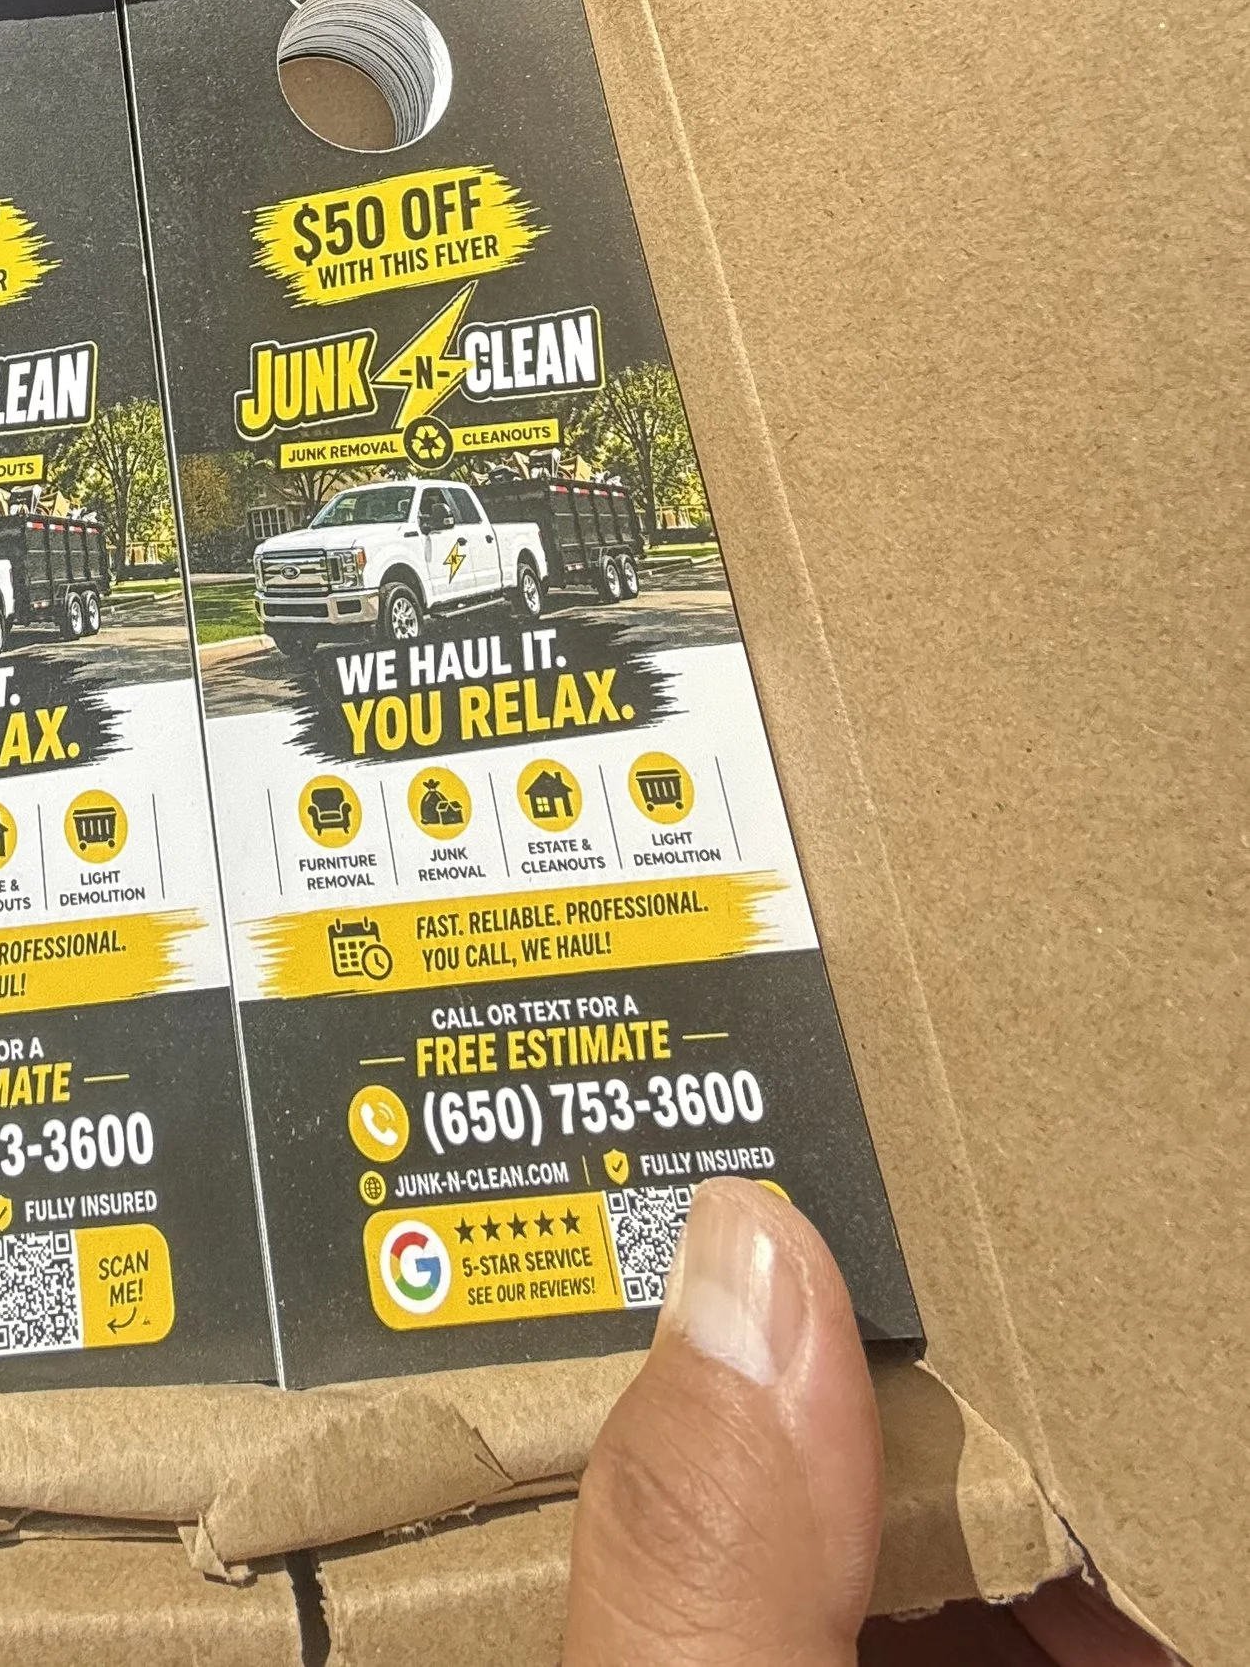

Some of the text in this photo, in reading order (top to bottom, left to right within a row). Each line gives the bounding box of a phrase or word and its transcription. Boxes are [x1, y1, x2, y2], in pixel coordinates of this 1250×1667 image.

[293, 176, 481, 266] $50 OFF
[318, 234, 500, 290] WITH THIS FLYER
[241, 337, 369, 431] JUNK
[463, 314, 596, 394] CLEAN
[462, 426, 551, 446] CLEANOUTS
[288, 439, 398, 463] JUNK REMOVAL
[336, 629, 567, 695] WE HAUL IT.
[341, 668, 635, 756] YOU RELAX.
[527, 838, 592, 856] ESTATE &
[651, 830, 692, 847] LIGHT
[299, 852, 378, 873] FURNITURE
[429, 846, 468, 863] JUNK
[521, 854, 606, 875] CLEANOUTS
[633, 847, 722, 868] DEMOLITION
[9, 879, 20, 893] &
[79, 869, 120, 886] LIGHT
[306, 871, 375, 890] REMOVAL
[418, 863, 486, 882] REMOVAL
[59, 886, 146, 908] DEMOLITION
[416, 890, 709, 940] FAST. RELIABLE. PROFESSIONAL.
[422, 932, 612, 973] YOU CALL, WE HAUL!
[431, 994, 639, 1030] CALL OR TEXT FOR A
[28, 1036, 44, 1059] A
[416, 1019, 671, 1078] FREE ESTIMATE
[423, 1069, 765, 1155] (650) 753-3600
[640, 1146, 776, 1177] FULLY INSURED
[394, 1162, 570, 1199] JUNK-N-CLEAN.COM
[24, 1189, 158, 1223] FULLY INSURED
[98, 1249, 150, 1282] SCAN
[461, 1246, 593, 1278] 5-STAR SERVICE
[109, 1279, 144, 1307] ME!
[467, 1277, 596, 1306] SEE OUR REVIEWS!
